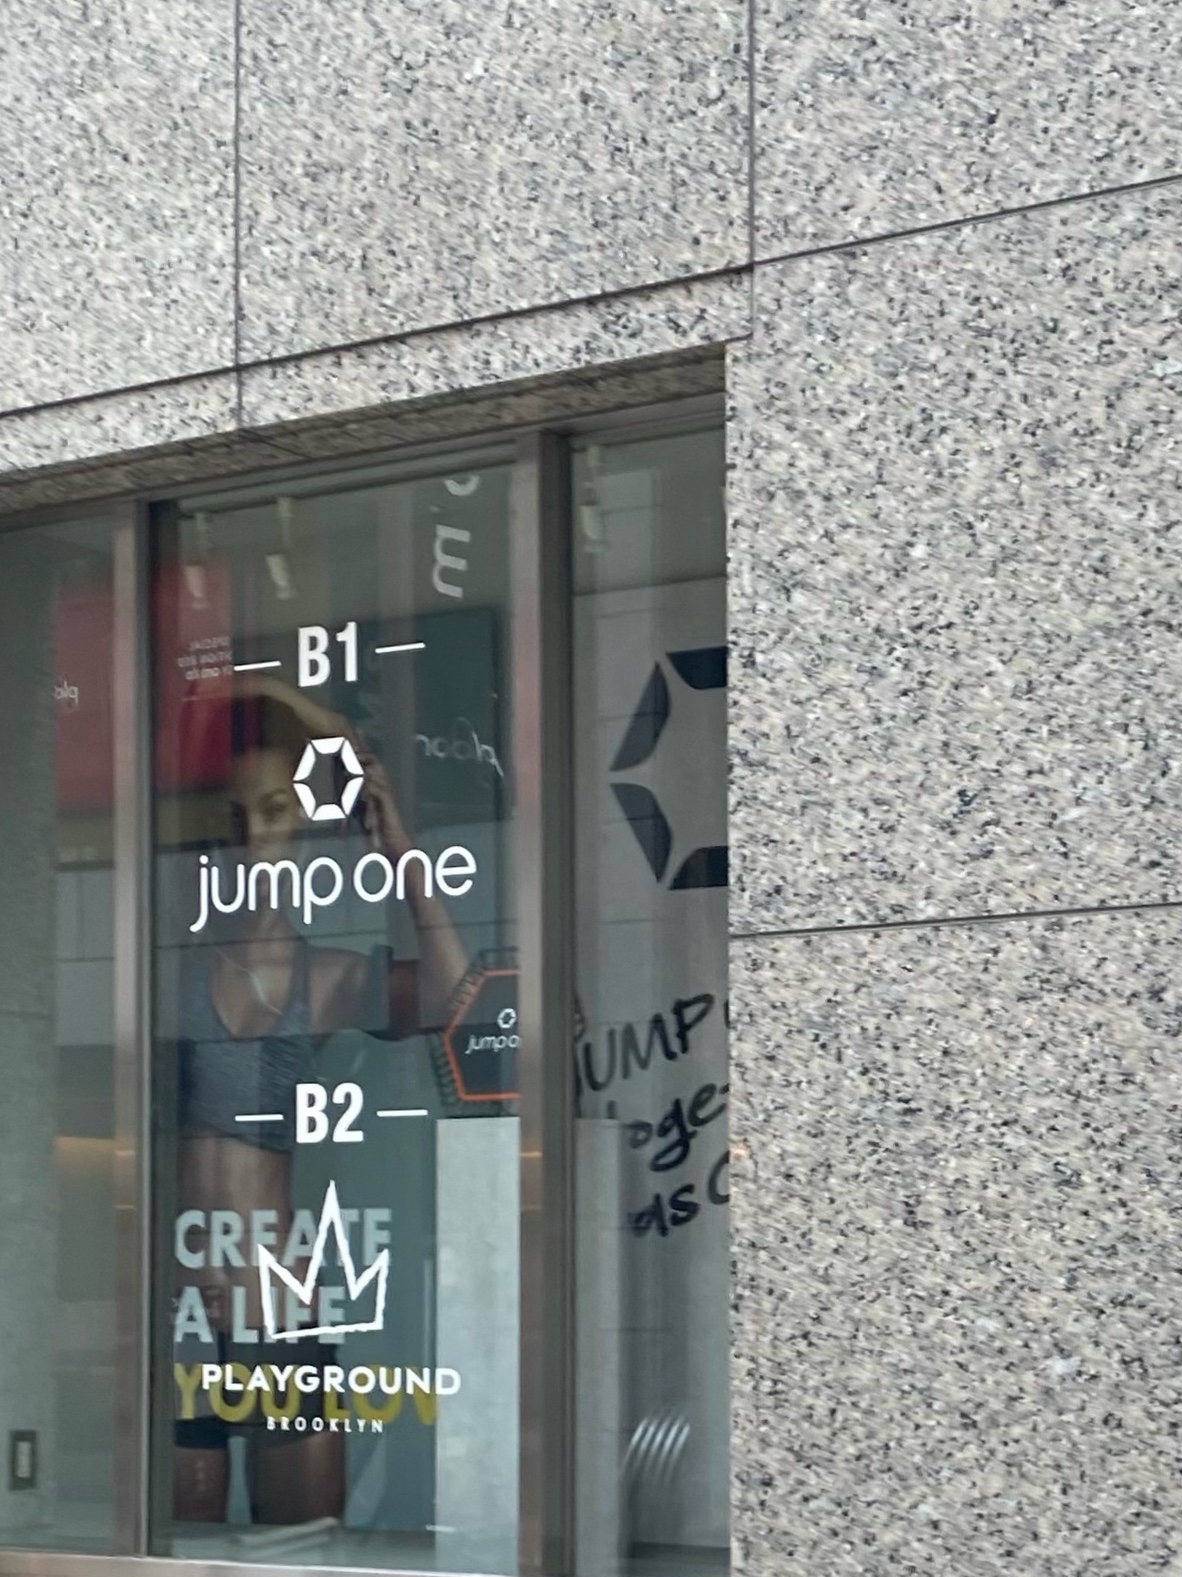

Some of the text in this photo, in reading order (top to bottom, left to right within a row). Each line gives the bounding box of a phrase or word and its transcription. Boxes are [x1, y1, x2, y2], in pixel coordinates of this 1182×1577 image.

[298, 621, 359, 687] B1
[190, 846, 477, 932] jump one
[295, 1083, 364, 1143] B2
[175, 1208, 392, 1269] CREATE
[174, 1286, 346, 1344] A LIFE
[173, 1363, 301, 1422] YOU
[202, 1364, 461, 1395] PLAYGROUND
[267, 1416, 383, 1432] BROOKLYN
